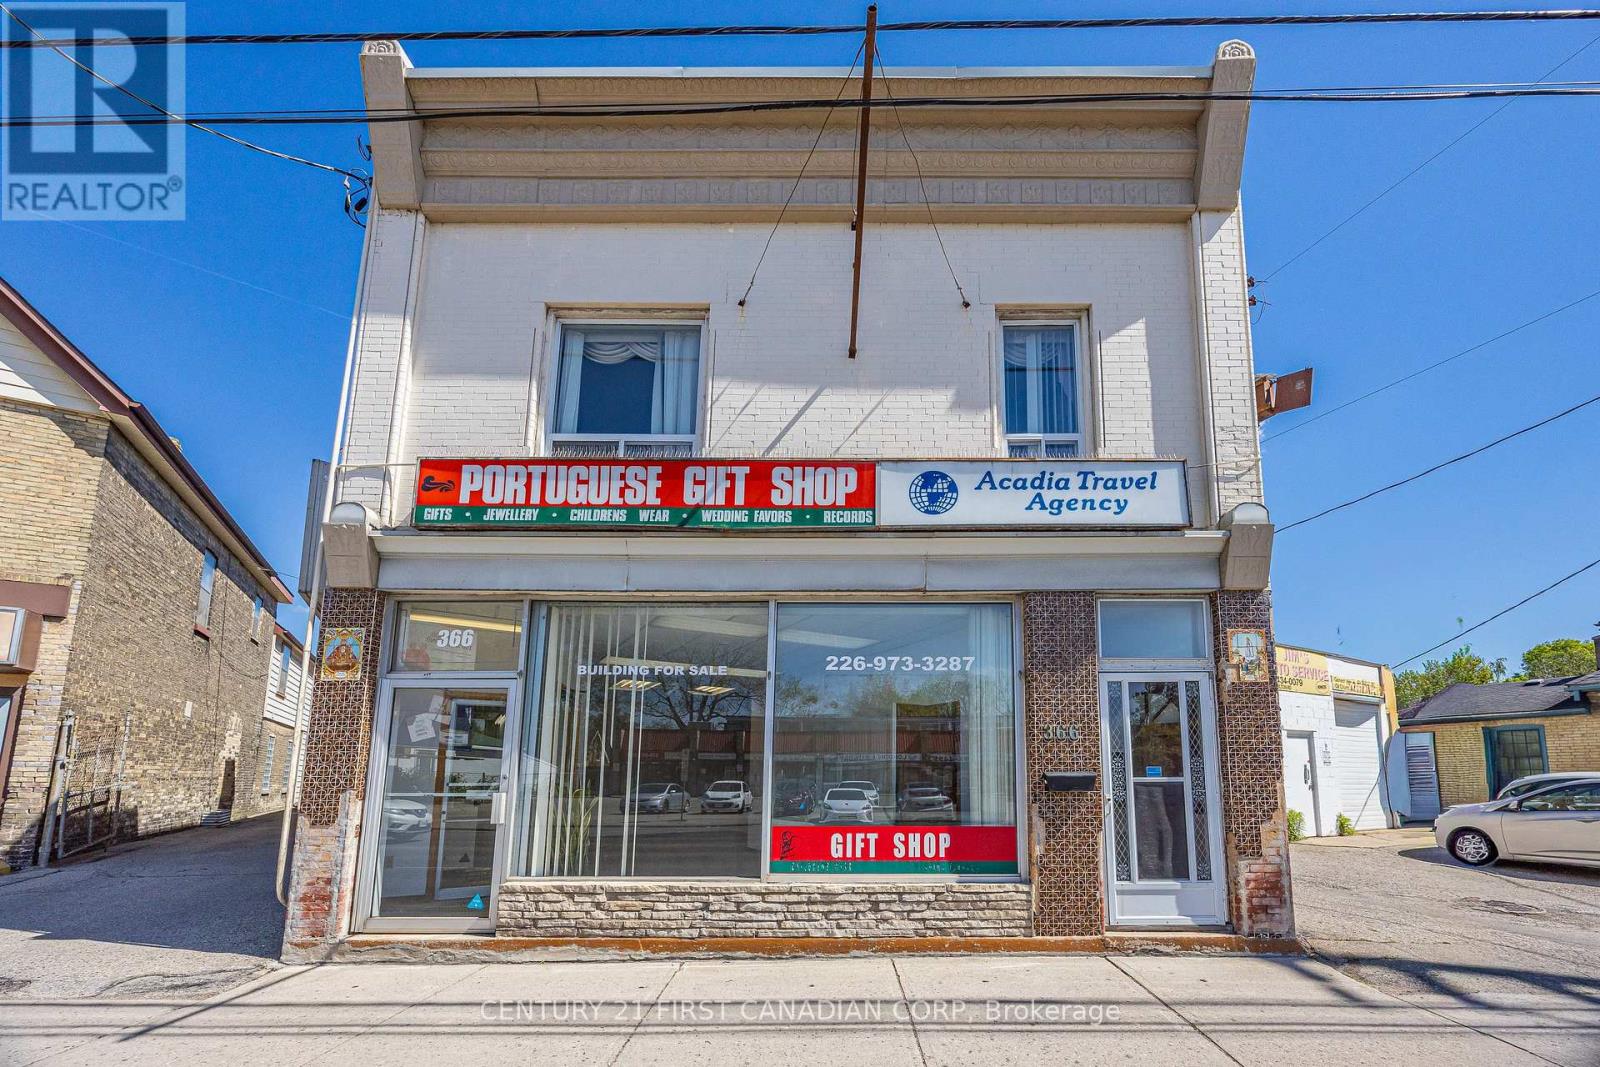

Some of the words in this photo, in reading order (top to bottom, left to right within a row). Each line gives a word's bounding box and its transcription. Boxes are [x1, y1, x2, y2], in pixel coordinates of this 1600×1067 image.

[459, 464, 662, 506] PORTUGUESE
[682, 465, 749, 506] GIFT
[770, 466, 858, 507] SHOP
[974, 470, 1071, 491] Acadia
[1077, 470, 1158, 491] Travel
[1025, 492, 1129, 515] Agency
[423, 508, 453, 522] GIFTS
[483, 508, 540, 522] JEWELLERY
[569, 508, 627, 523] CHILDRENS
[639, 509, 670, 523] WEAR
[701, 509, 750, 524] WEDDING
[753, 509, 793, 524] FAVORS
[823, 509, 874, 525] RECORDS
[437, 629, 474, 648] 366
[577, 664, 650, 677] BUILDING
[654, 664, 685, 677] FOR
[688, 664, 728, 677] SALE
[825, 655, 976, 672] 226-973-3287
[1292, 665, 1329, 682] SERVICE
[1043, 723, 1079, 741] 366
[830, 833, 879, 859] GIFT
[893, 832, 951, 859] SHOP
